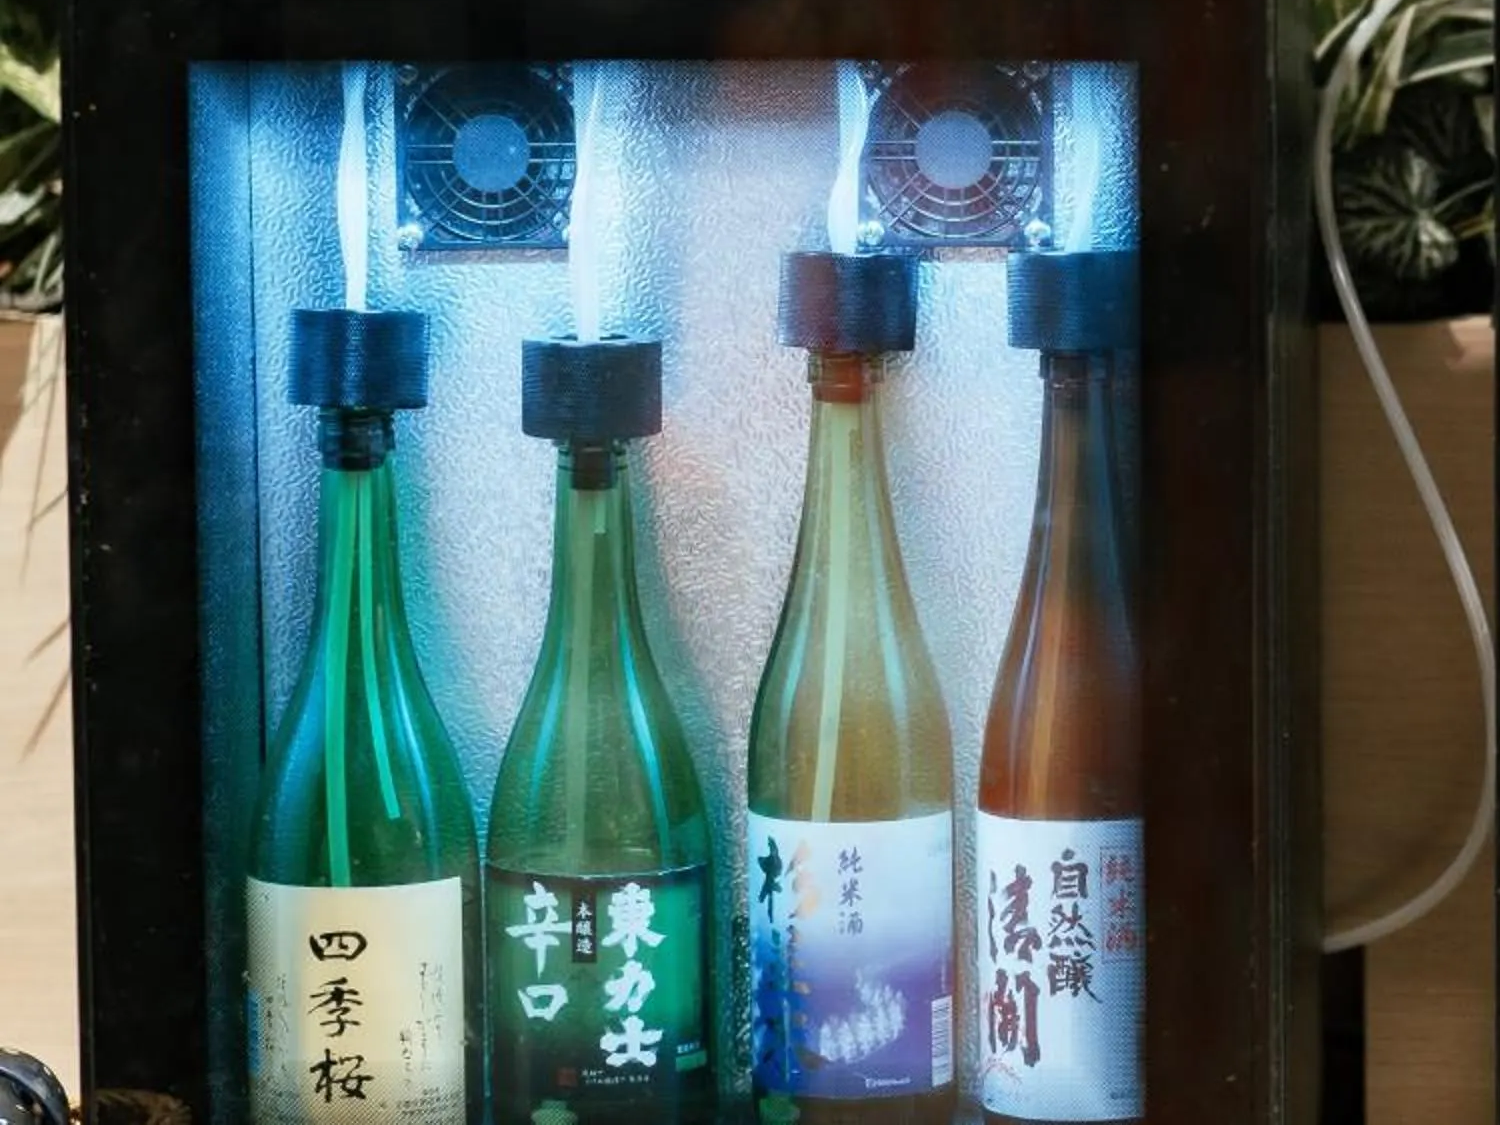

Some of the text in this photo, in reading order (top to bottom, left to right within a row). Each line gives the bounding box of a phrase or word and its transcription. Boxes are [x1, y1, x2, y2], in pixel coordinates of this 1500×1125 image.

[505, 880, 573, 1022] 辛口
[575, 900, 593, 955] 本醸造
[836, 845, 864, 937] 純米酒
[307, 930, 375, 1103] 四季桜
[600, 881, 668, 1068] 東力士
